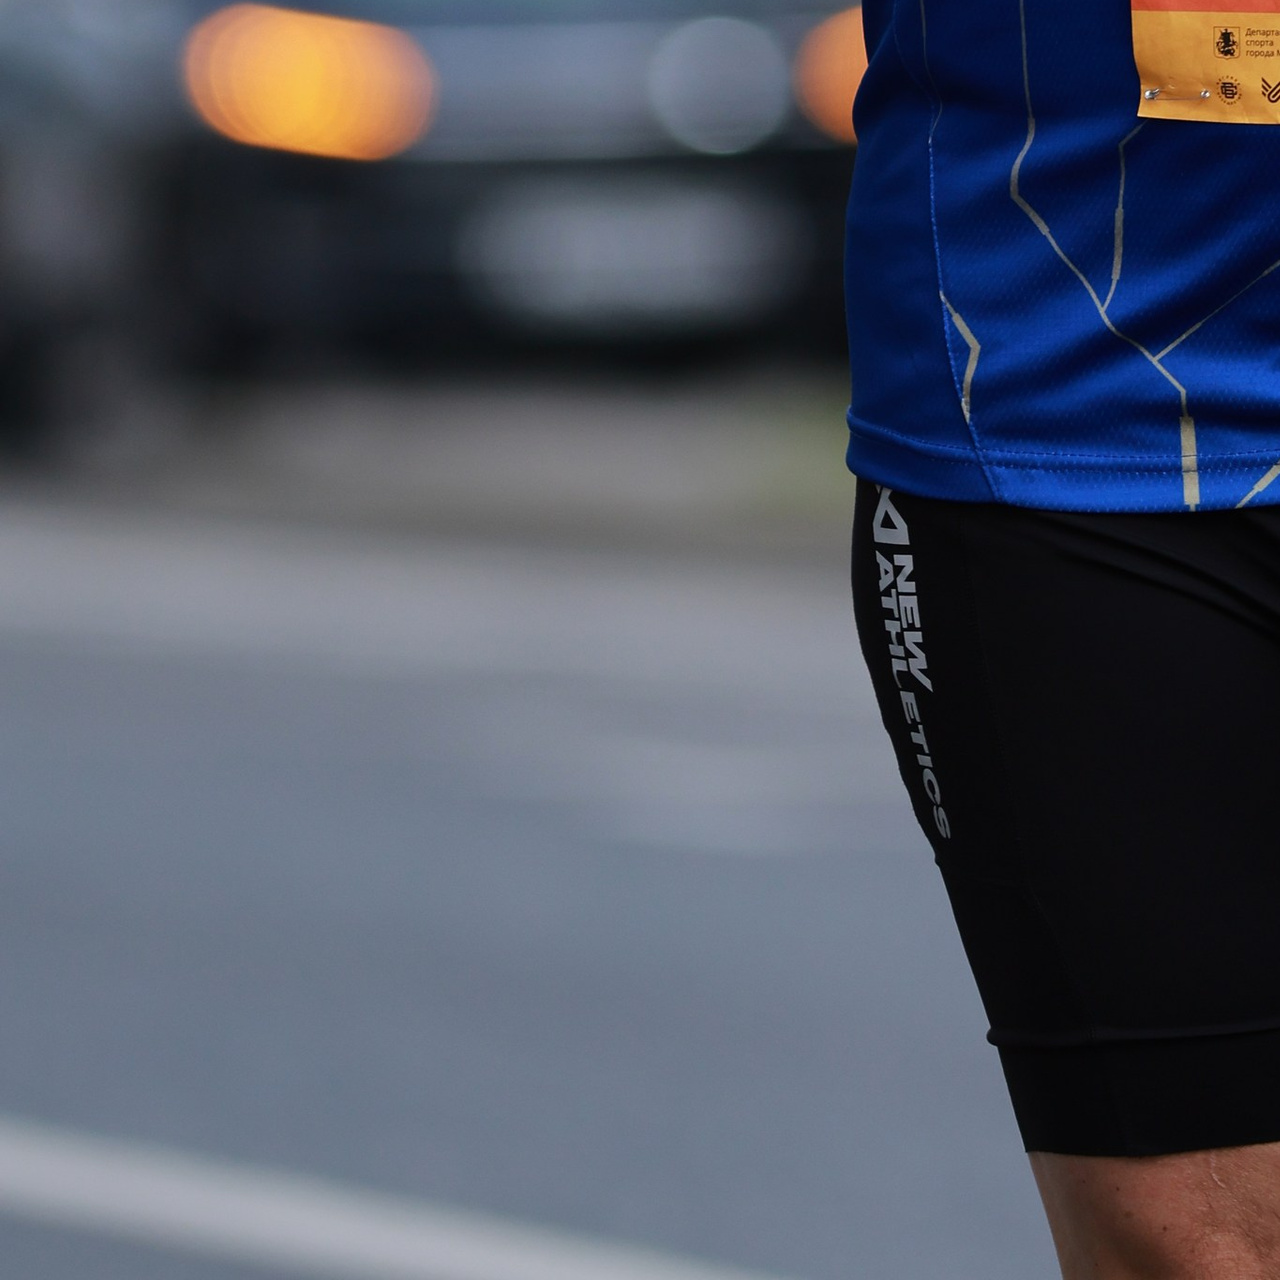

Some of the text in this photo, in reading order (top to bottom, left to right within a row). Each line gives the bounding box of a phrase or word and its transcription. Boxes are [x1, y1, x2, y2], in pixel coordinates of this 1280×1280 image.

[1245, 40, 1274, 48] спорта
[1245, 50, 1275, 58] города
[893, 554, 934, 692] NEW
[875, 550, 951, 840] ATHLETICS
